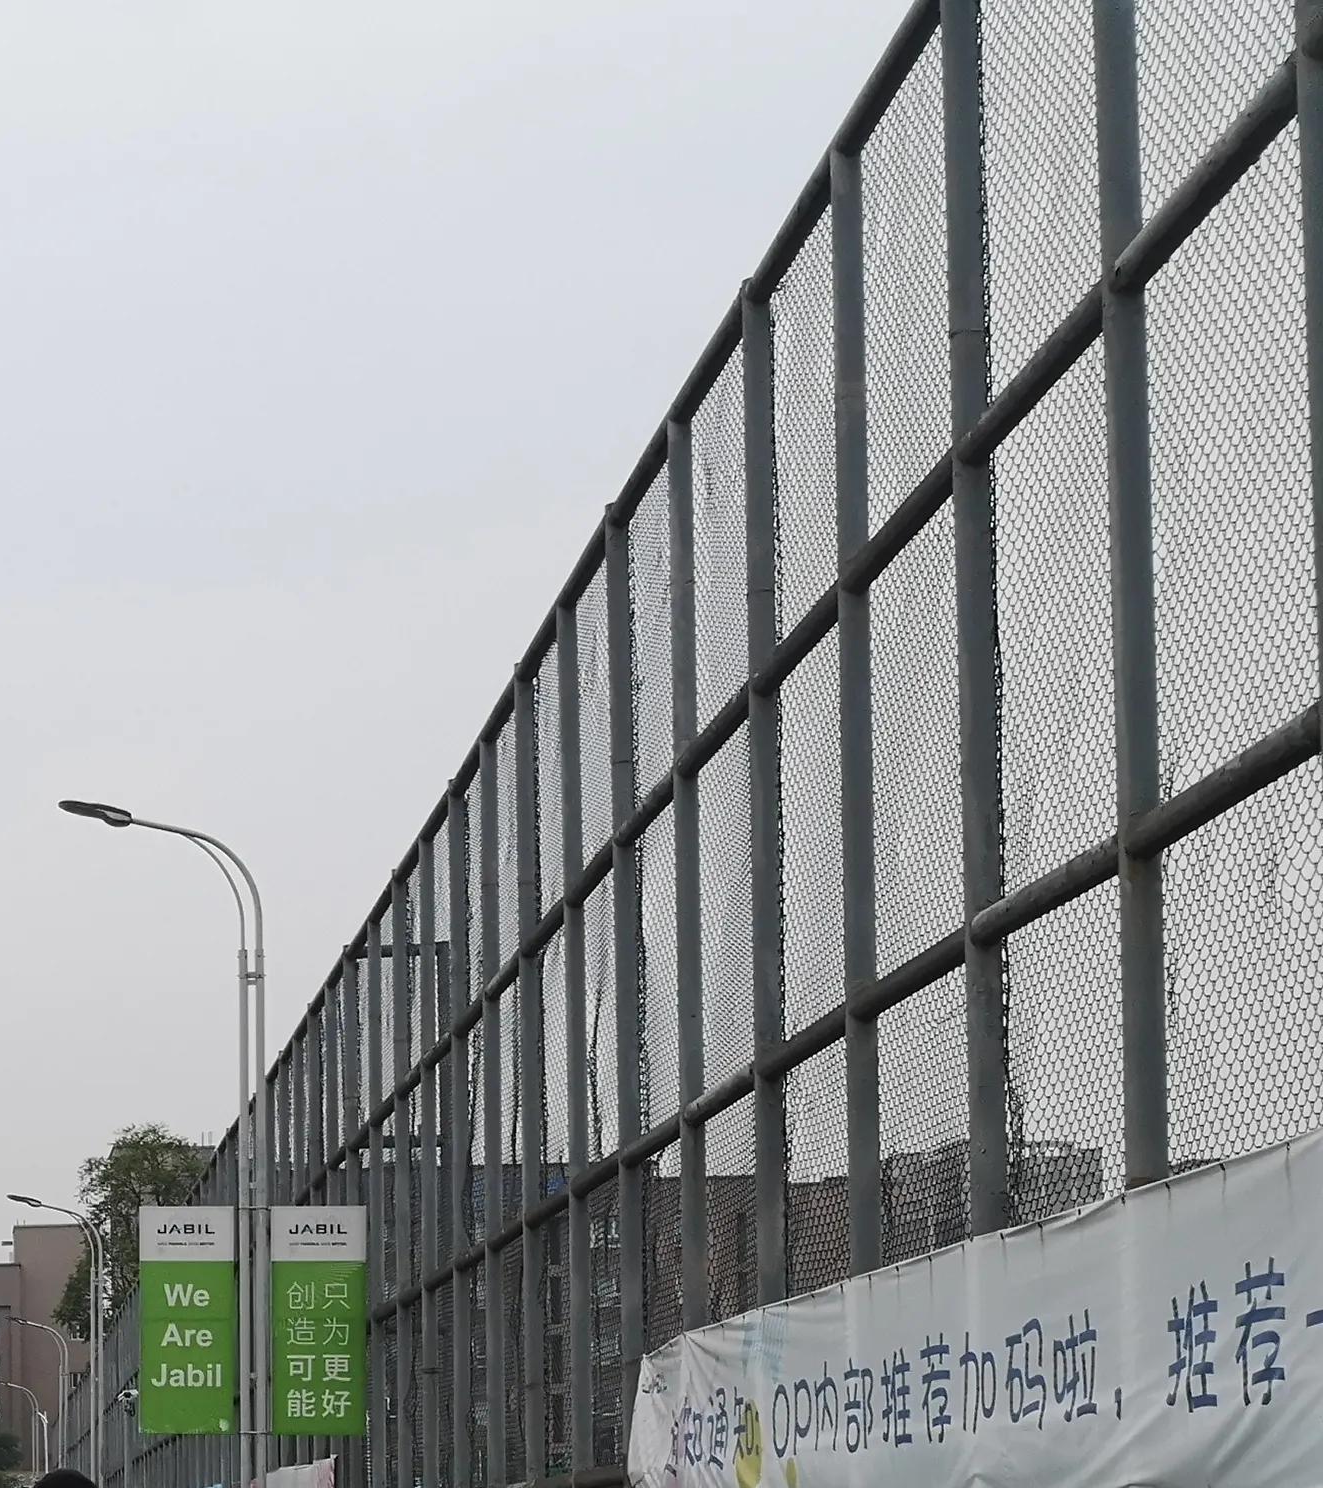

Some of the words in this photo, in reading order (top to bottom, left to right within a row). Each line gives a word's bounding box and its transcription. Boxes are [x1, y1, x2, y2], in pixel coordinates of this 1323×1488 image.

[156, 1223, 216, 1235] JABIL
[288, 1223, 348, 1235] JABIL
[163, 1282, 211, 1307] We
[160, 1322, 214, 1348] Are
[286, 1281, 316, 1418] 创造可能
[321, 1281, 353, 1418] 只为更好
[151, 1362, 222, 1388] Jabil
